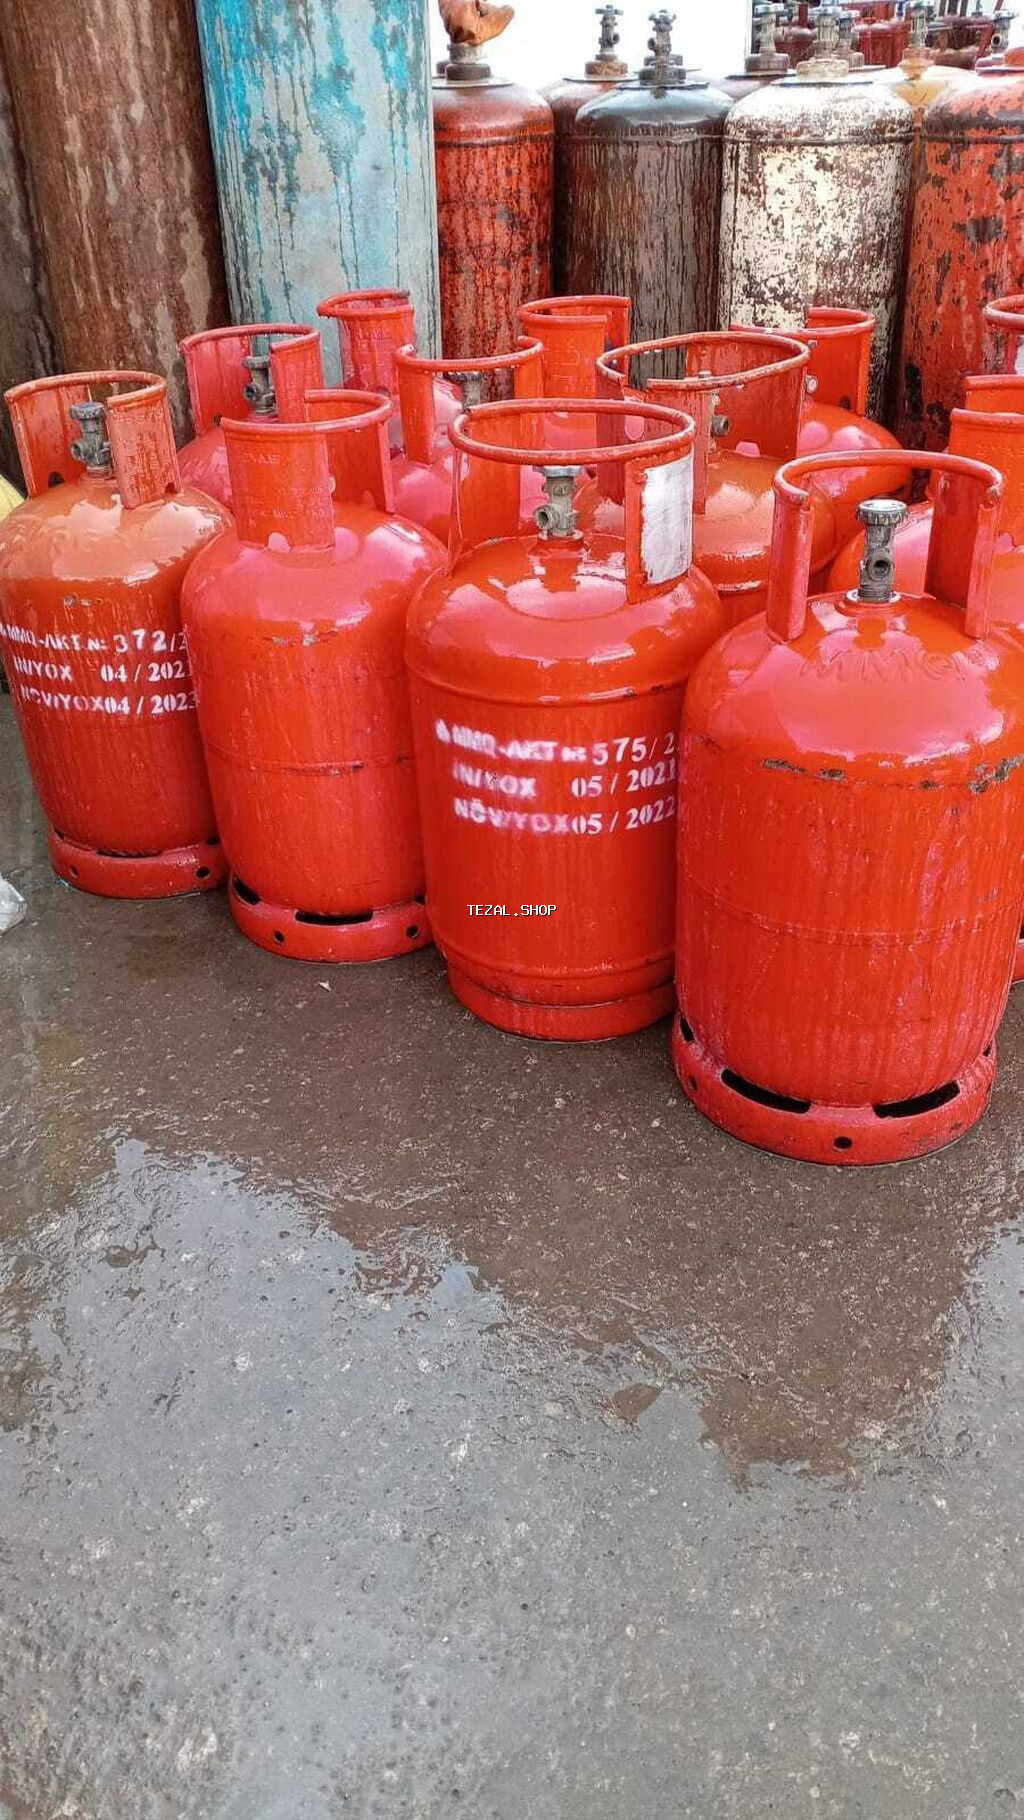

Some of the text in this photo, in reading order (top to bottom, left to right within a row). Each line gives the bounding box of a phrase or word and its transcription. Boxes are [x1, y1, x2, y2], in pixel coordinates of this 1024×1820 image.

[148, 660, 191, 682] 202
[571, 775, 603, 797] 05
[626, 758, 676, 792] 2021
[625, 797, 676, 829] 2022
